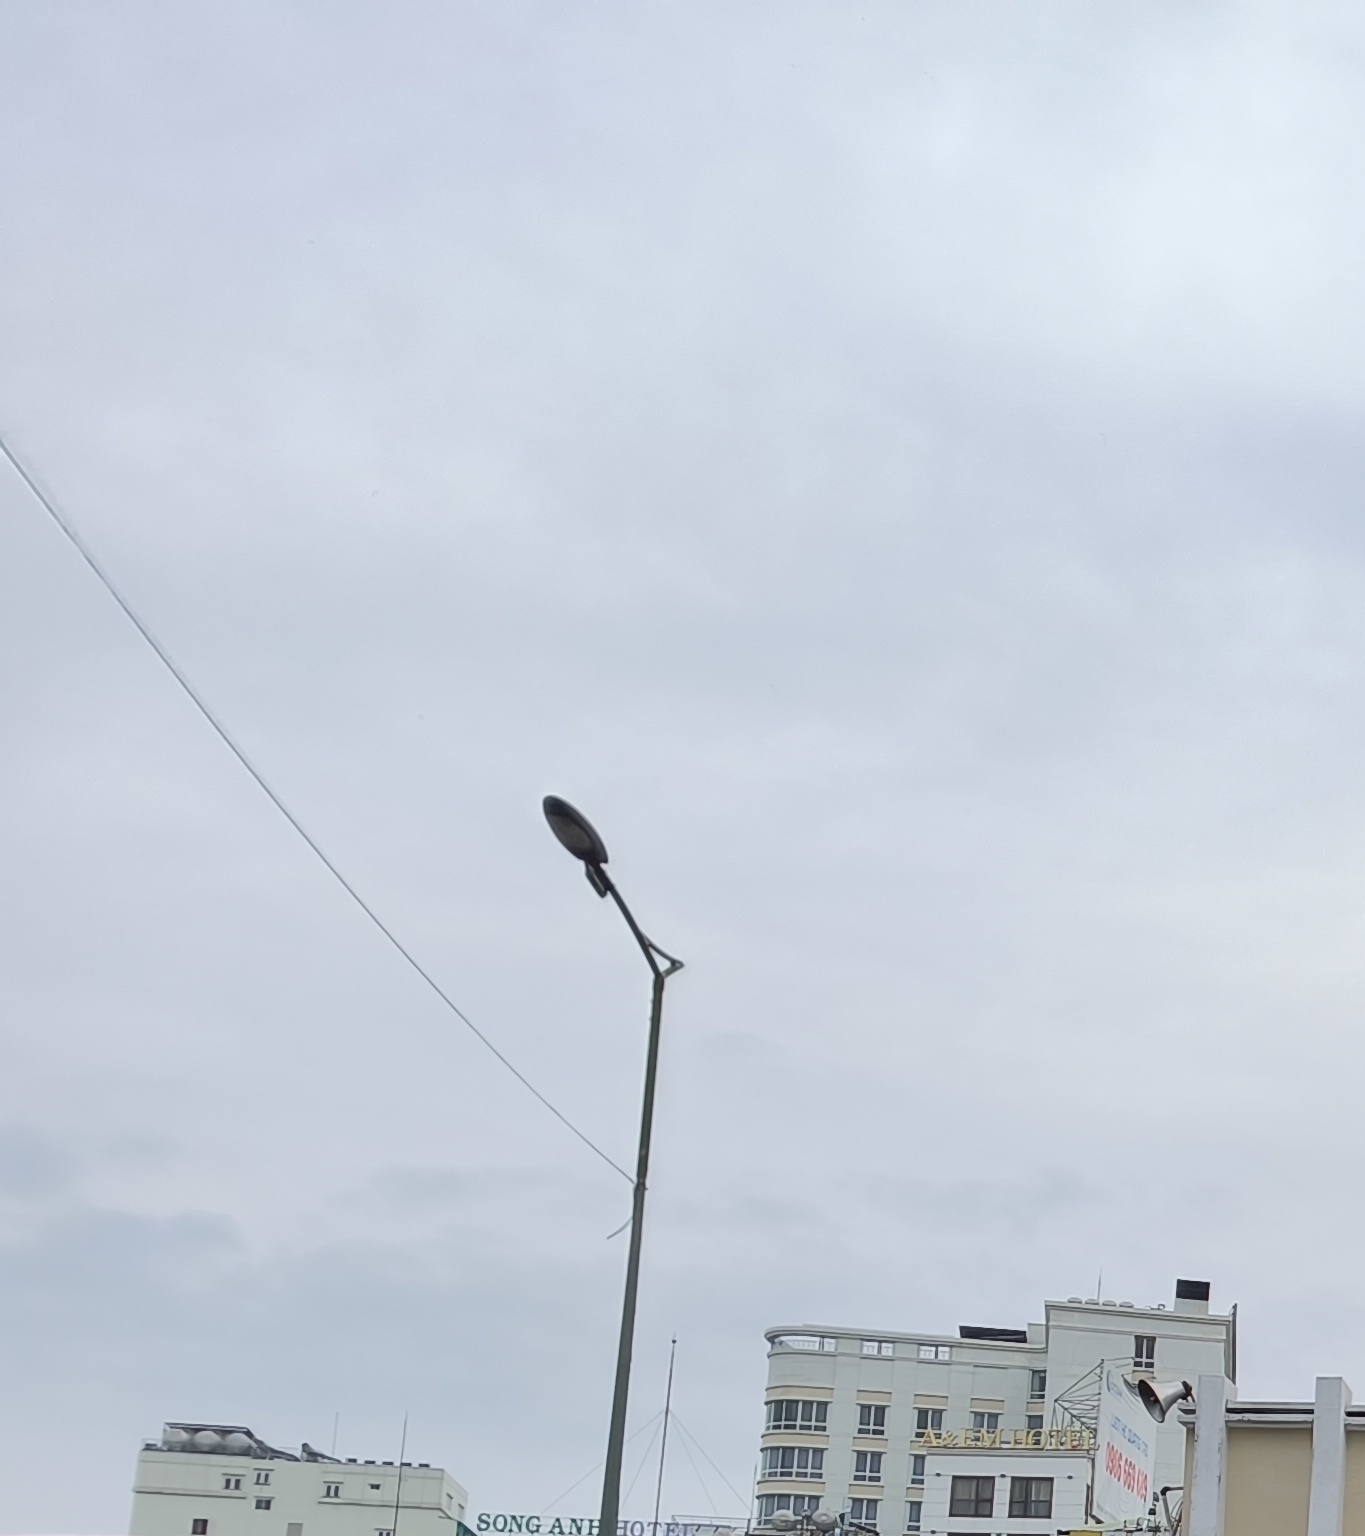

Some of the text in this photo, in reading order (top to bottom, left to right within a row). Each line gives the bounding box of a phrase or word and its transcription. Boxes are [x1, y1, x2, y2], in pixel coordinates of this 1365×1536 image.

[1009, 1429, 1100, 1451] HOTEL
[477, 1512, 543, 1533] SONG
[548, 1517, 601, 1536] ANH
